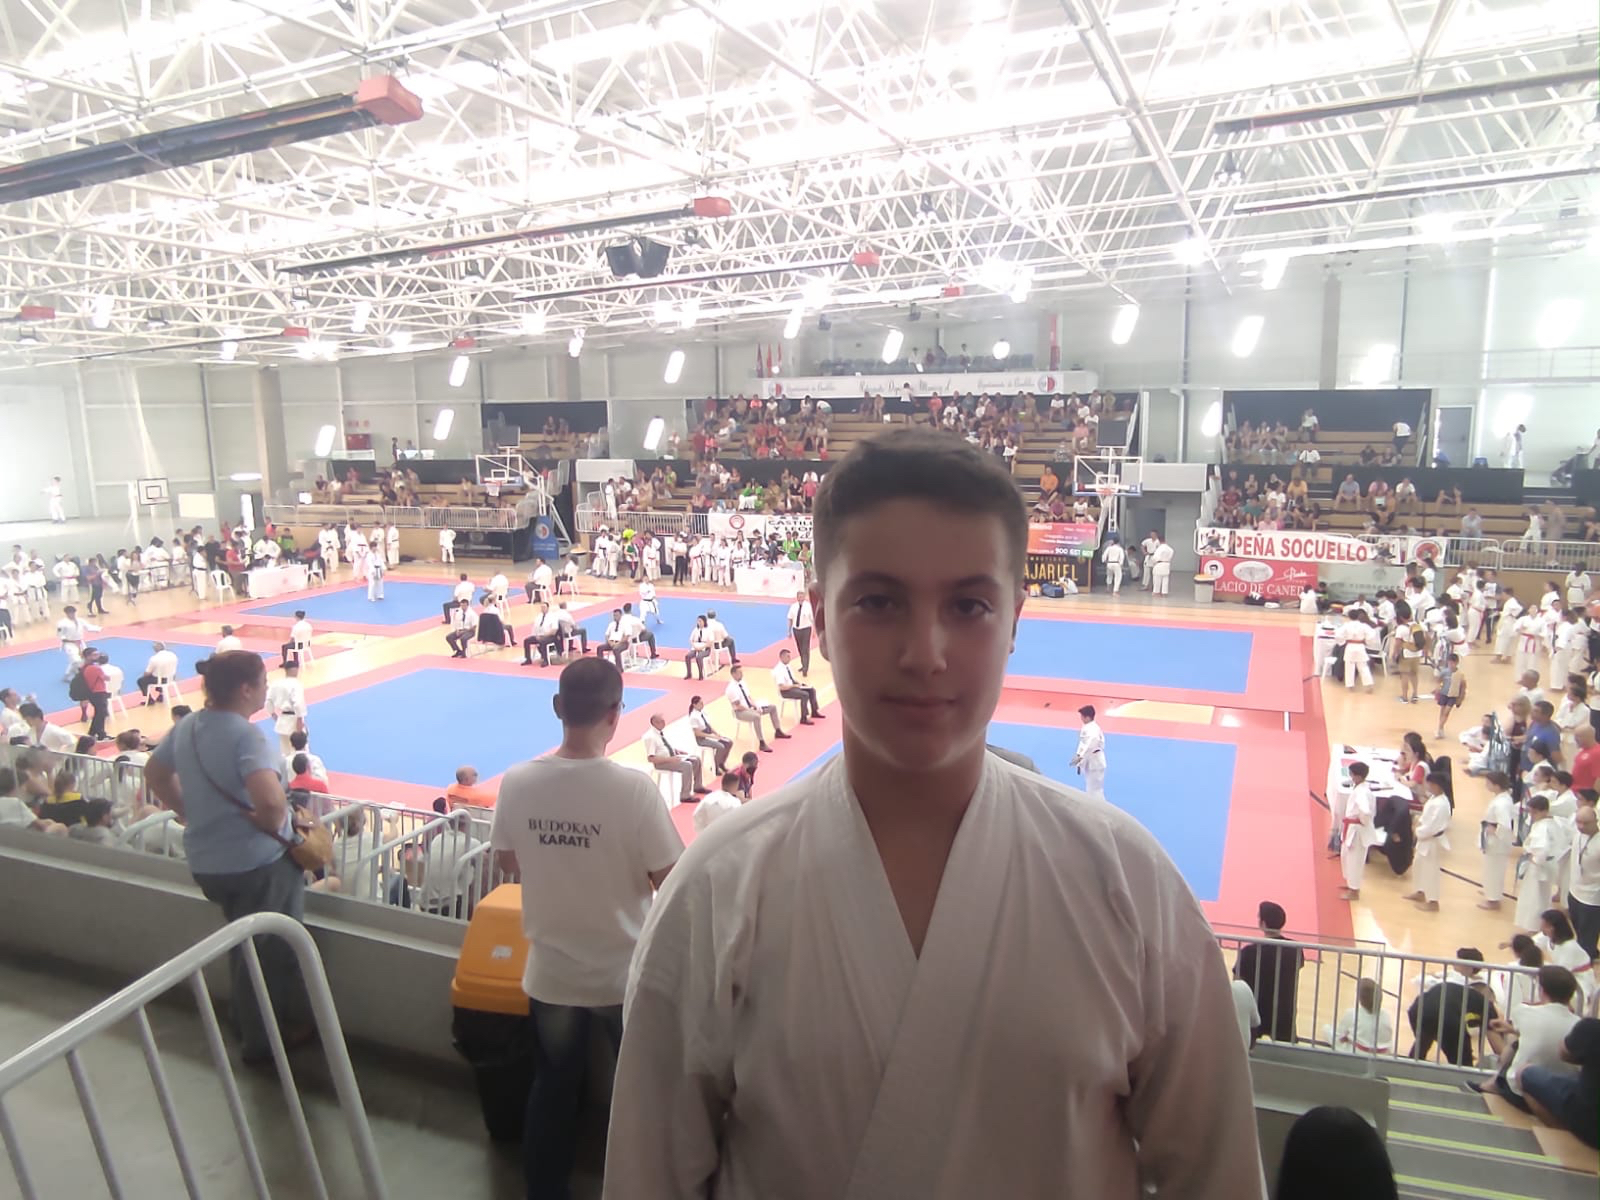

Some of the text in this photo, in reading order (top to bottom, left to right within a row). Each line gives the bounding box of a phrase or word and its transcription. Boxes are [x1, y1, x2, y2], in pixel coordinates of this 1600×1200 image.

[1280, 537, 1367, 562] SOCUELLO
[1024, 563, 1079, 581] AJARIEL
[1214, 580, 1304, 597] LACIO DE CANED
[528, 818, 602, 836] BUDOKAN
[539, 833, 591, 849] KARATE
